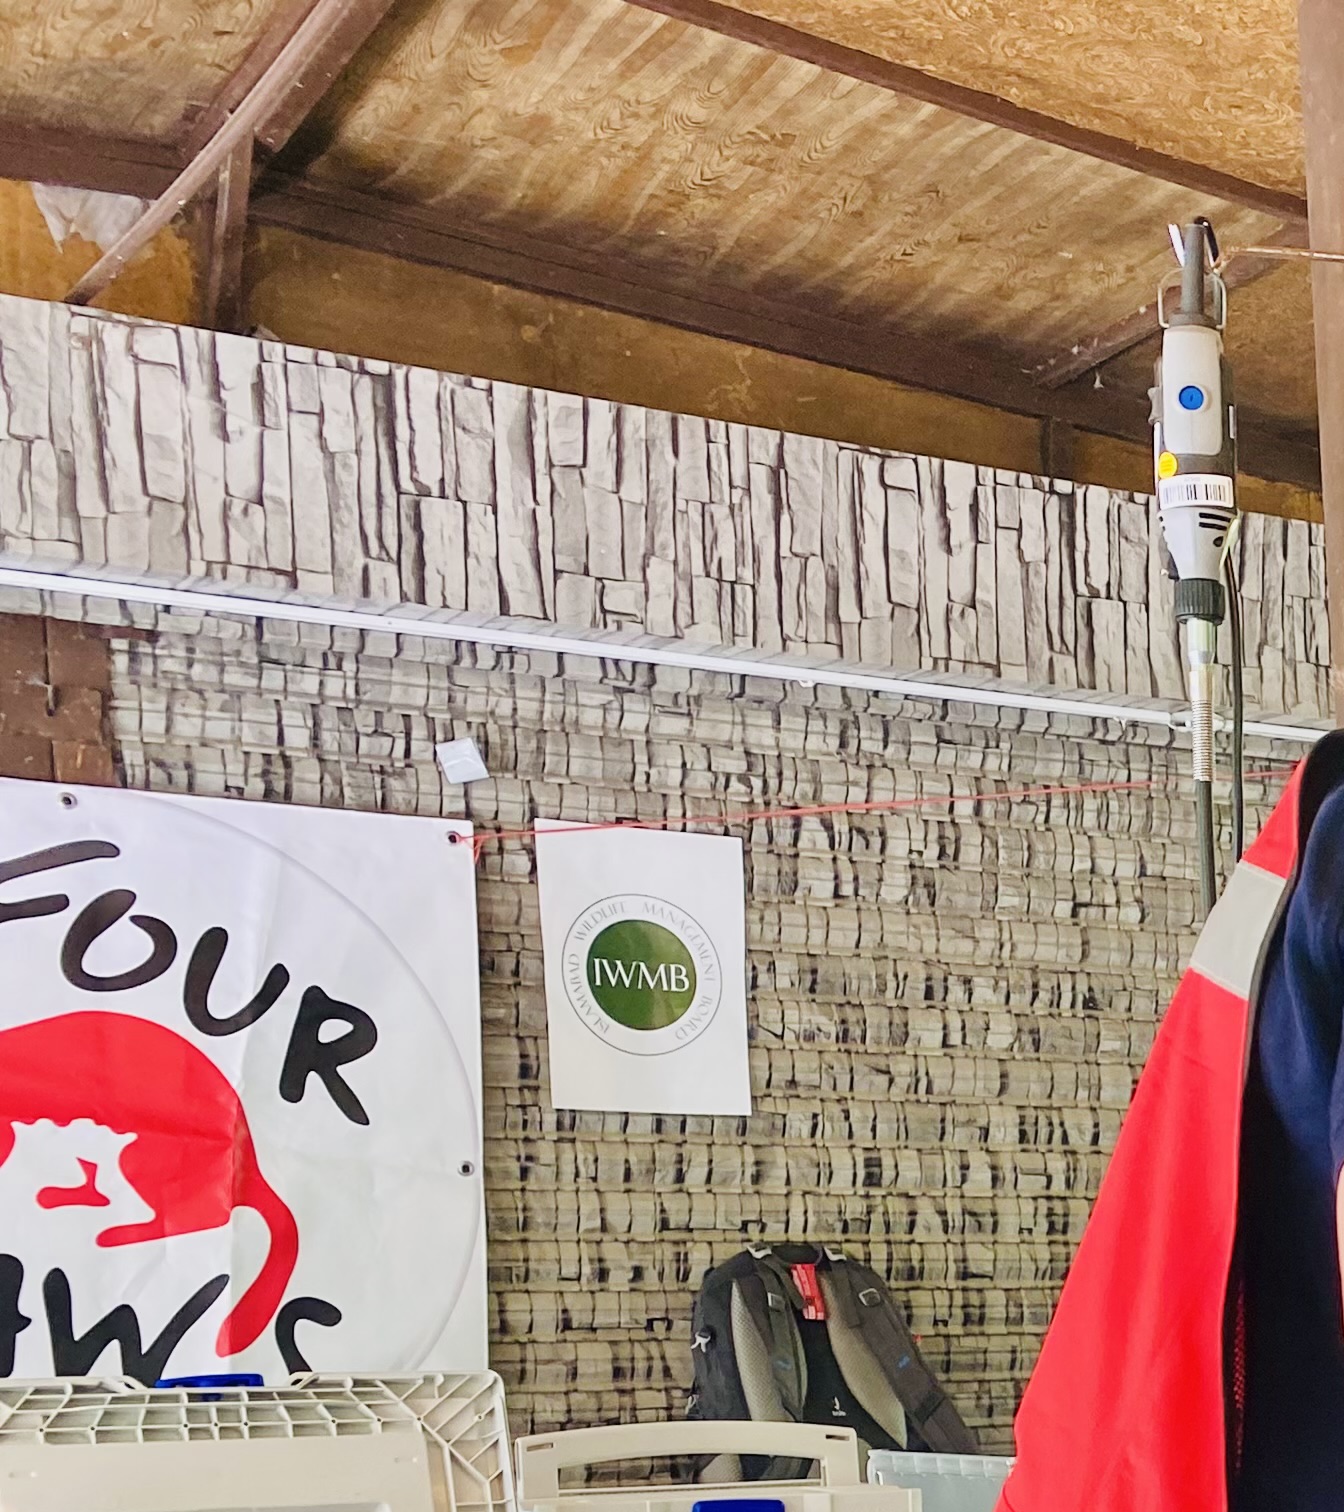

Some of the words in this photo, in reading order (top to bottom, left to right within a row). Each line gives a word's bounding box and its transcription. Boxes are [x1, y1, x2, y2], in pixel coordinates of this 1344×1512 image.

[573, 901, 626, 941] WILDLIFE
[641, 901, 716, 982] MANAGEMENT
[0, 840, 377, 1126] FOUR
[593, 957, 690, 992] IWMB
[674, 995, 713, 1041] BOARD
